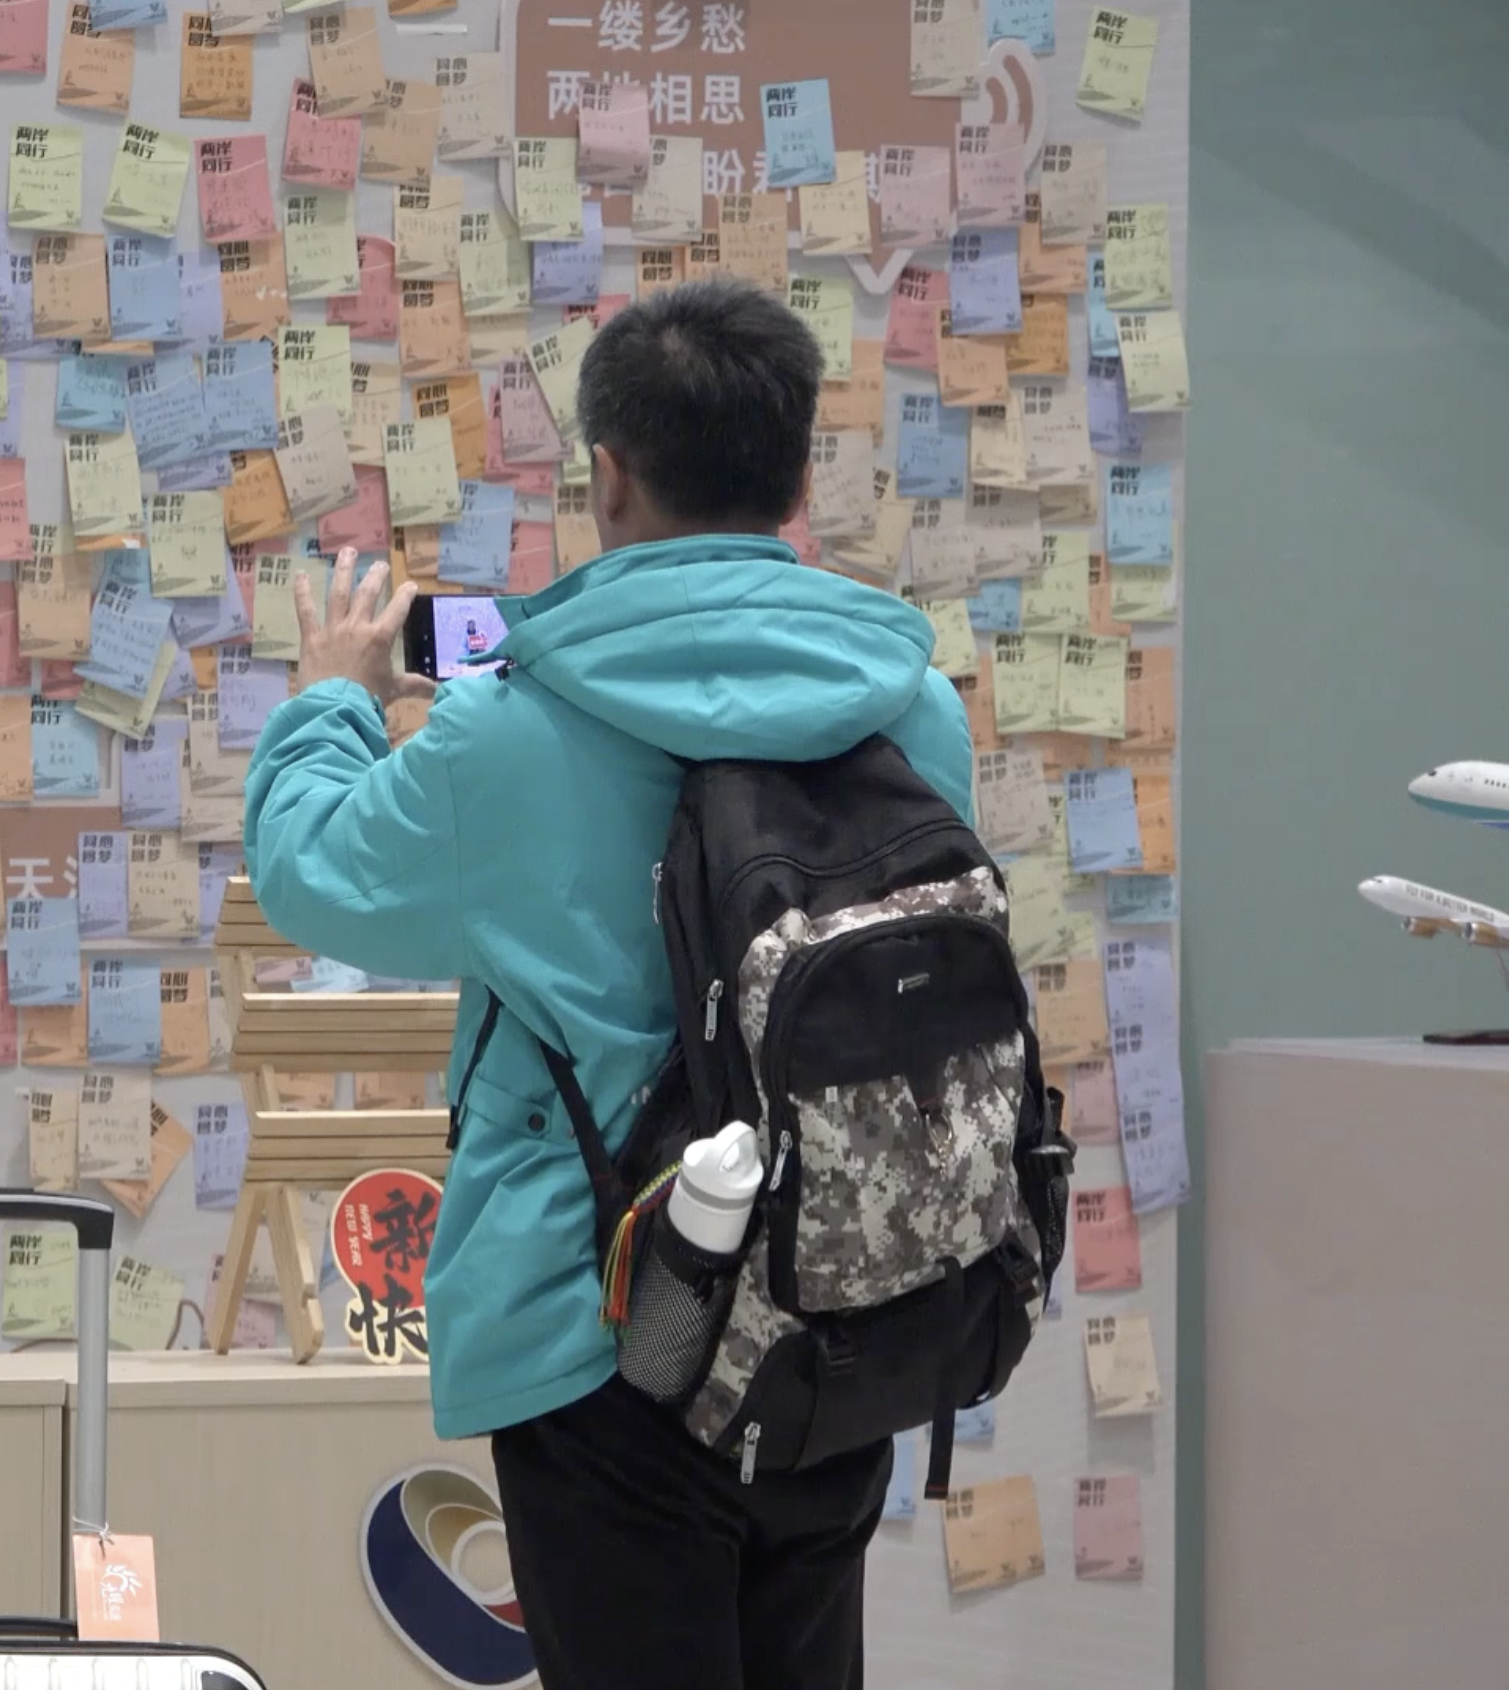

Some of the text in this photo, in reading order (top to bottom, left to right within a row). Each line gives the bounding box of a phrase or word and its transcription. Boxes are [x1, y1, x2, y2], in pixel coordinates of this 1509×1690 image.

[547, 0, 746, 52] 一缕乡愁
[1096, 10, 1127, 29] 两岸
[1092, 25, 1124, 45] 同行
[765, 86, 796, 102] 两岸
[767, 101, 797, 118] 同行
[15, 126, 49, 142] 两岸
[125, 124, 159, 143] 两岸
[15, 142, 48, 159] 同行
[122, 139, 155, 160] 同行
[199, 140, 232, 157] 两岸
[201, 157, 232, 174] 同行
[283, 330, 316, 345] 两岸
[283, 346, 314, 361] 同行
[358, 1203, 373, 1241] HAPPY
[9, 1234, 42, 1250] 两岸
[8, 1250, 41, 1266] 同行
